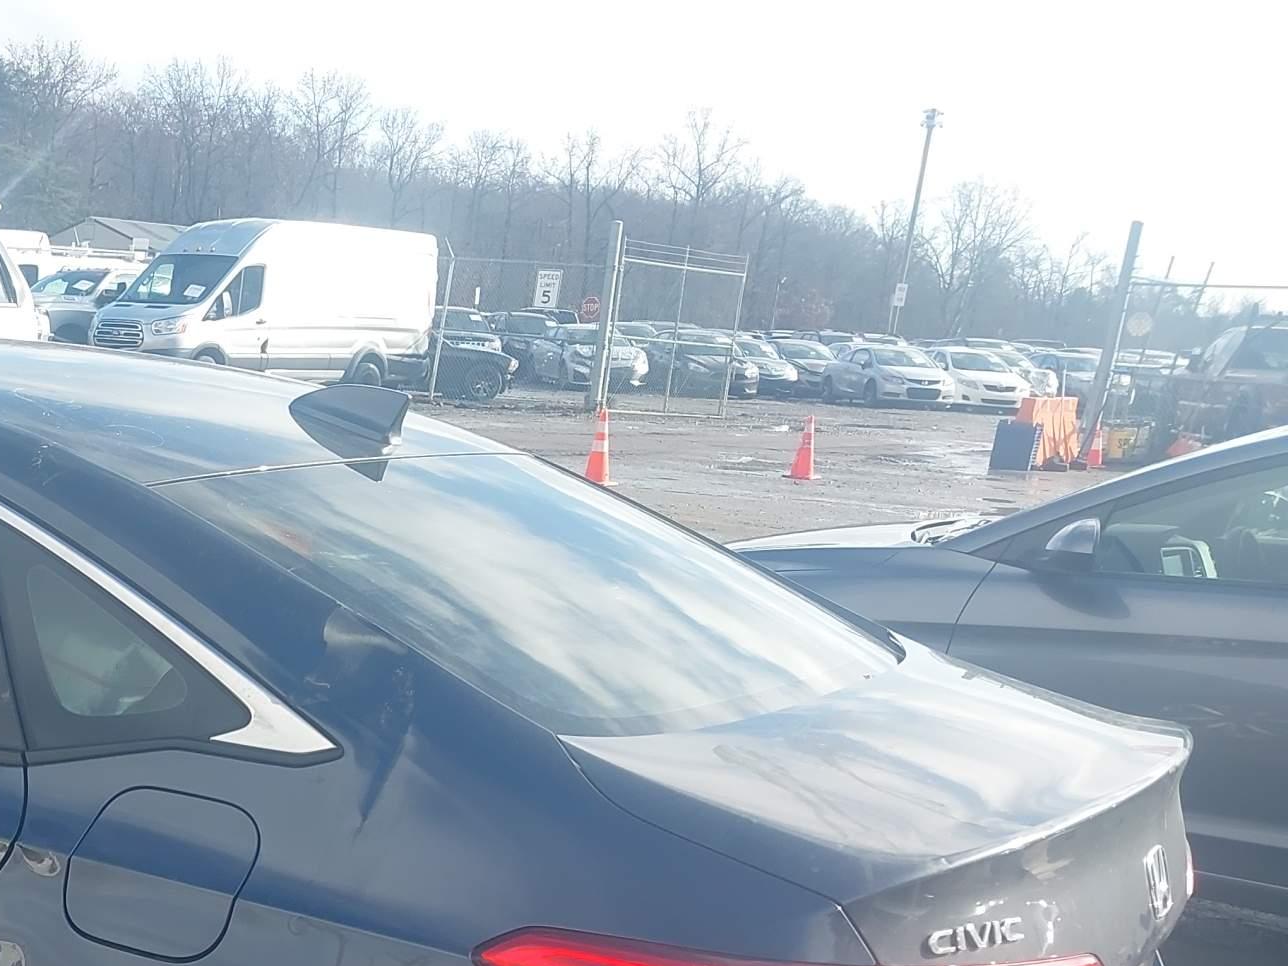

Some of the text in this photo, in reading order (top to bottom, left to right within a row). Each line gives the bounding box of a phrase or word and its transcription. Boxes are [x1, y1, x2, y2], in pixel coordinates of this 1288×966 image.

[541, 290, 551, 304] 5
[583, 303, 600, 312] STOP
[928, 917, 1024, 955] CIVIC
